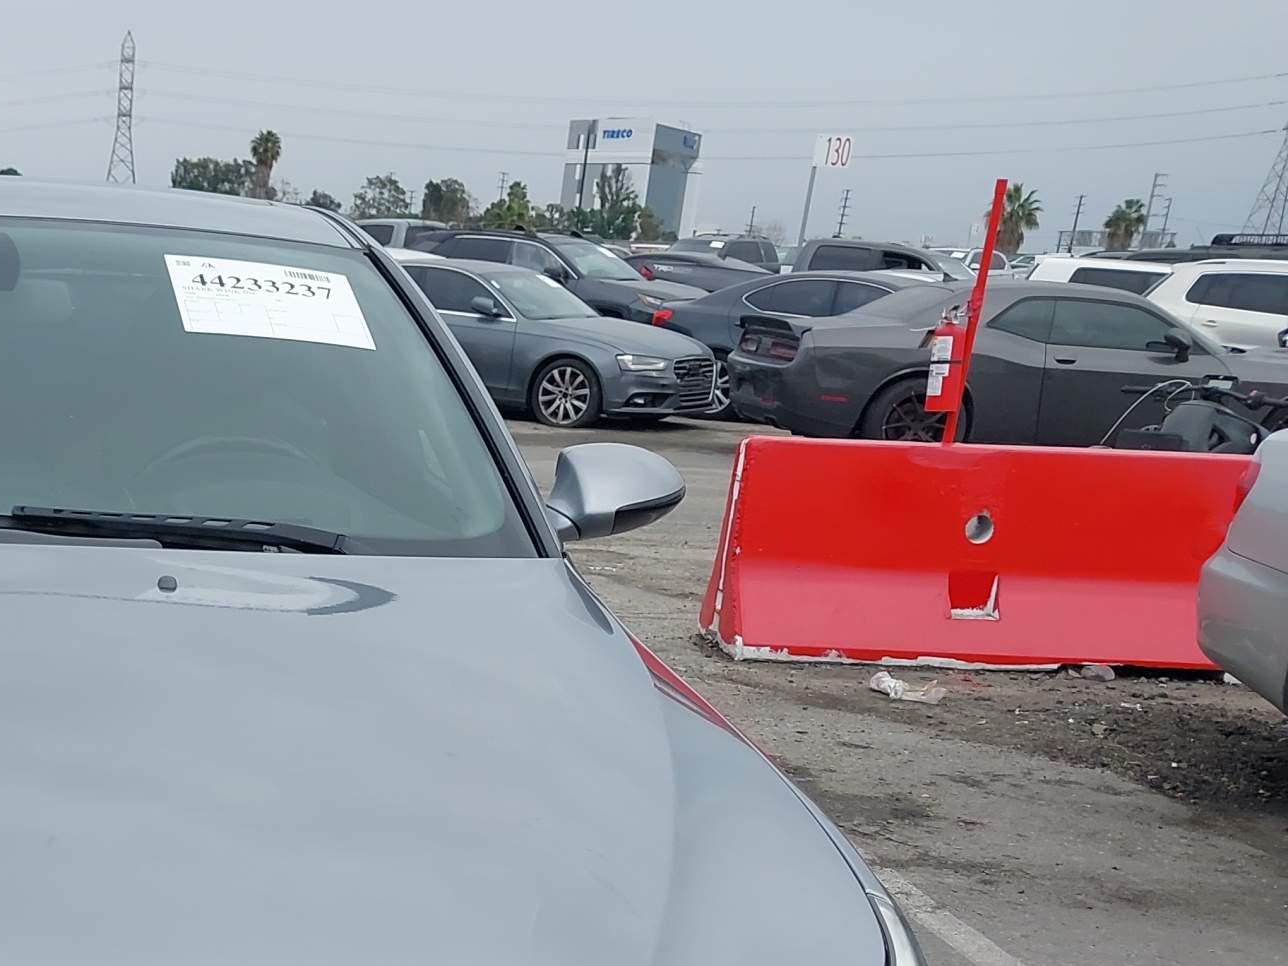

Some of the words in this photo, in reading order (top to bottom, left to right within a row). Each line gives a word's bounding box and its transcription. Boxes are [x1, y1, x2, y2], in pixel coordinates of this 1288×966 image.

[602, 129, 633, 139] TIRECO
[825, 137, 852, 167] 130
[192, 274, 331, 300] 44233237
